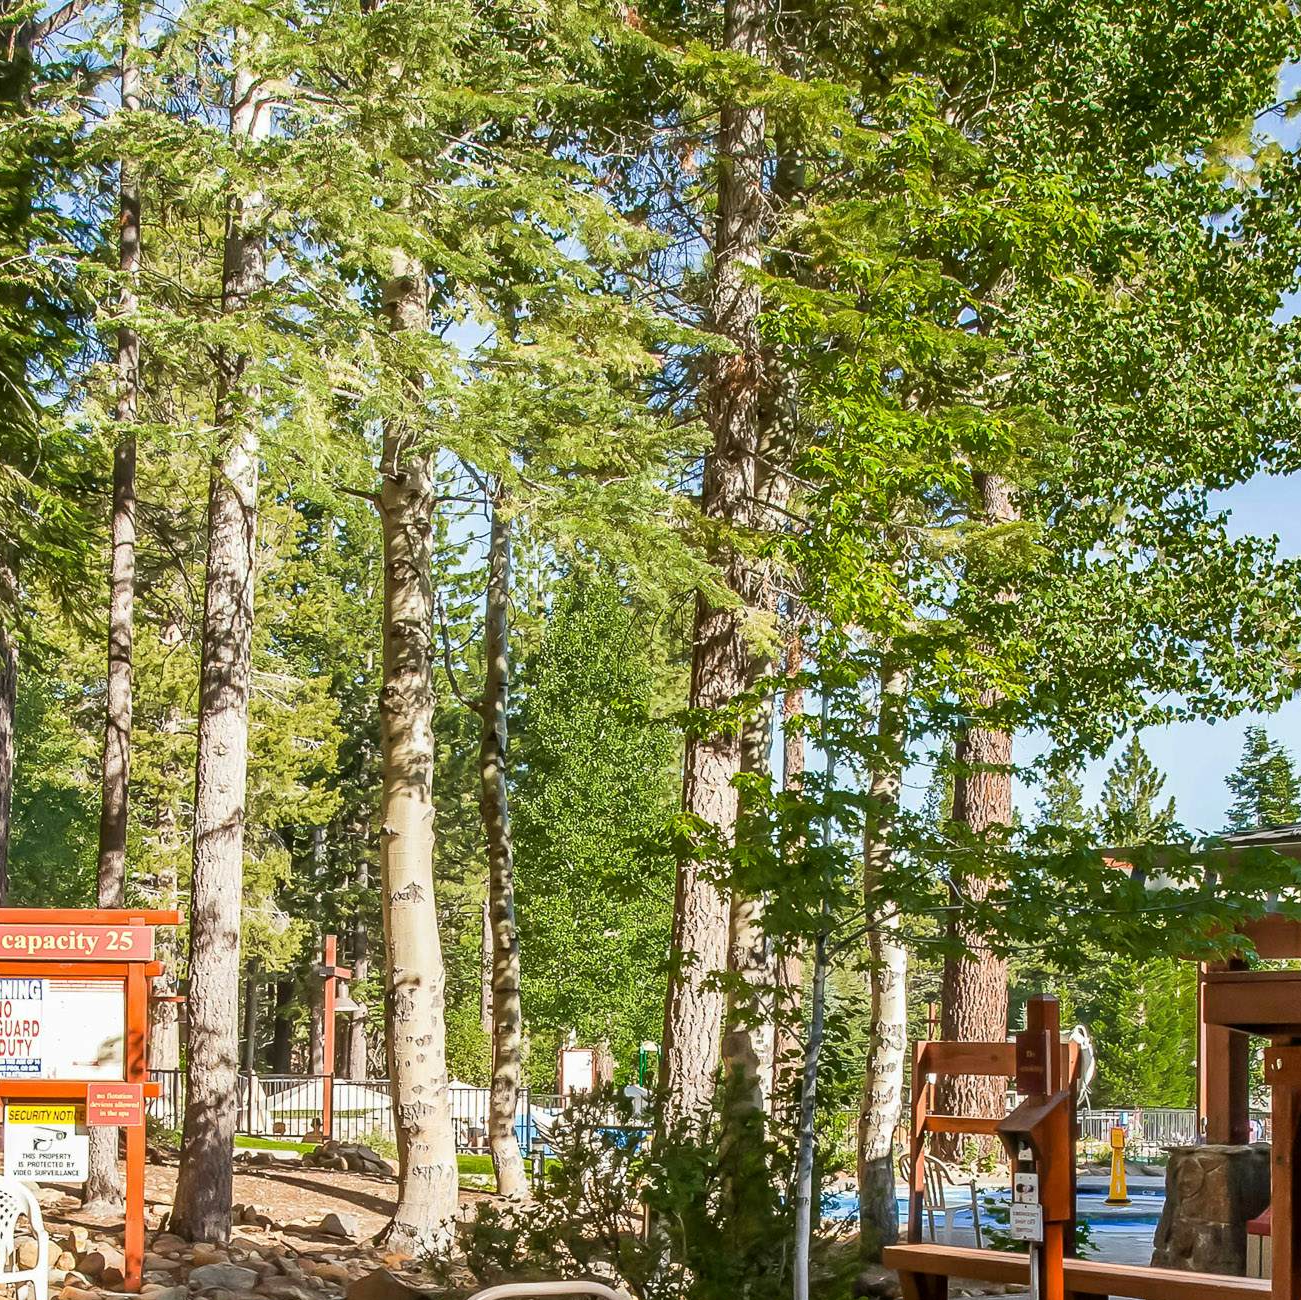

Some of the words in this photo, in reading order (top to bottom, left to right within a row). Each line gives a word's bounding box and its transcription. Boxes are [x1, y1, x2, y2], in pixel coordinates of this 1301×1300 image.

[1, 930, 99, 955] capacity
[105, 930, 134, 951] 25
[8, 1110, 52, 1121] SECURITY
[53, 1110, 86, 1121] NOTICE
